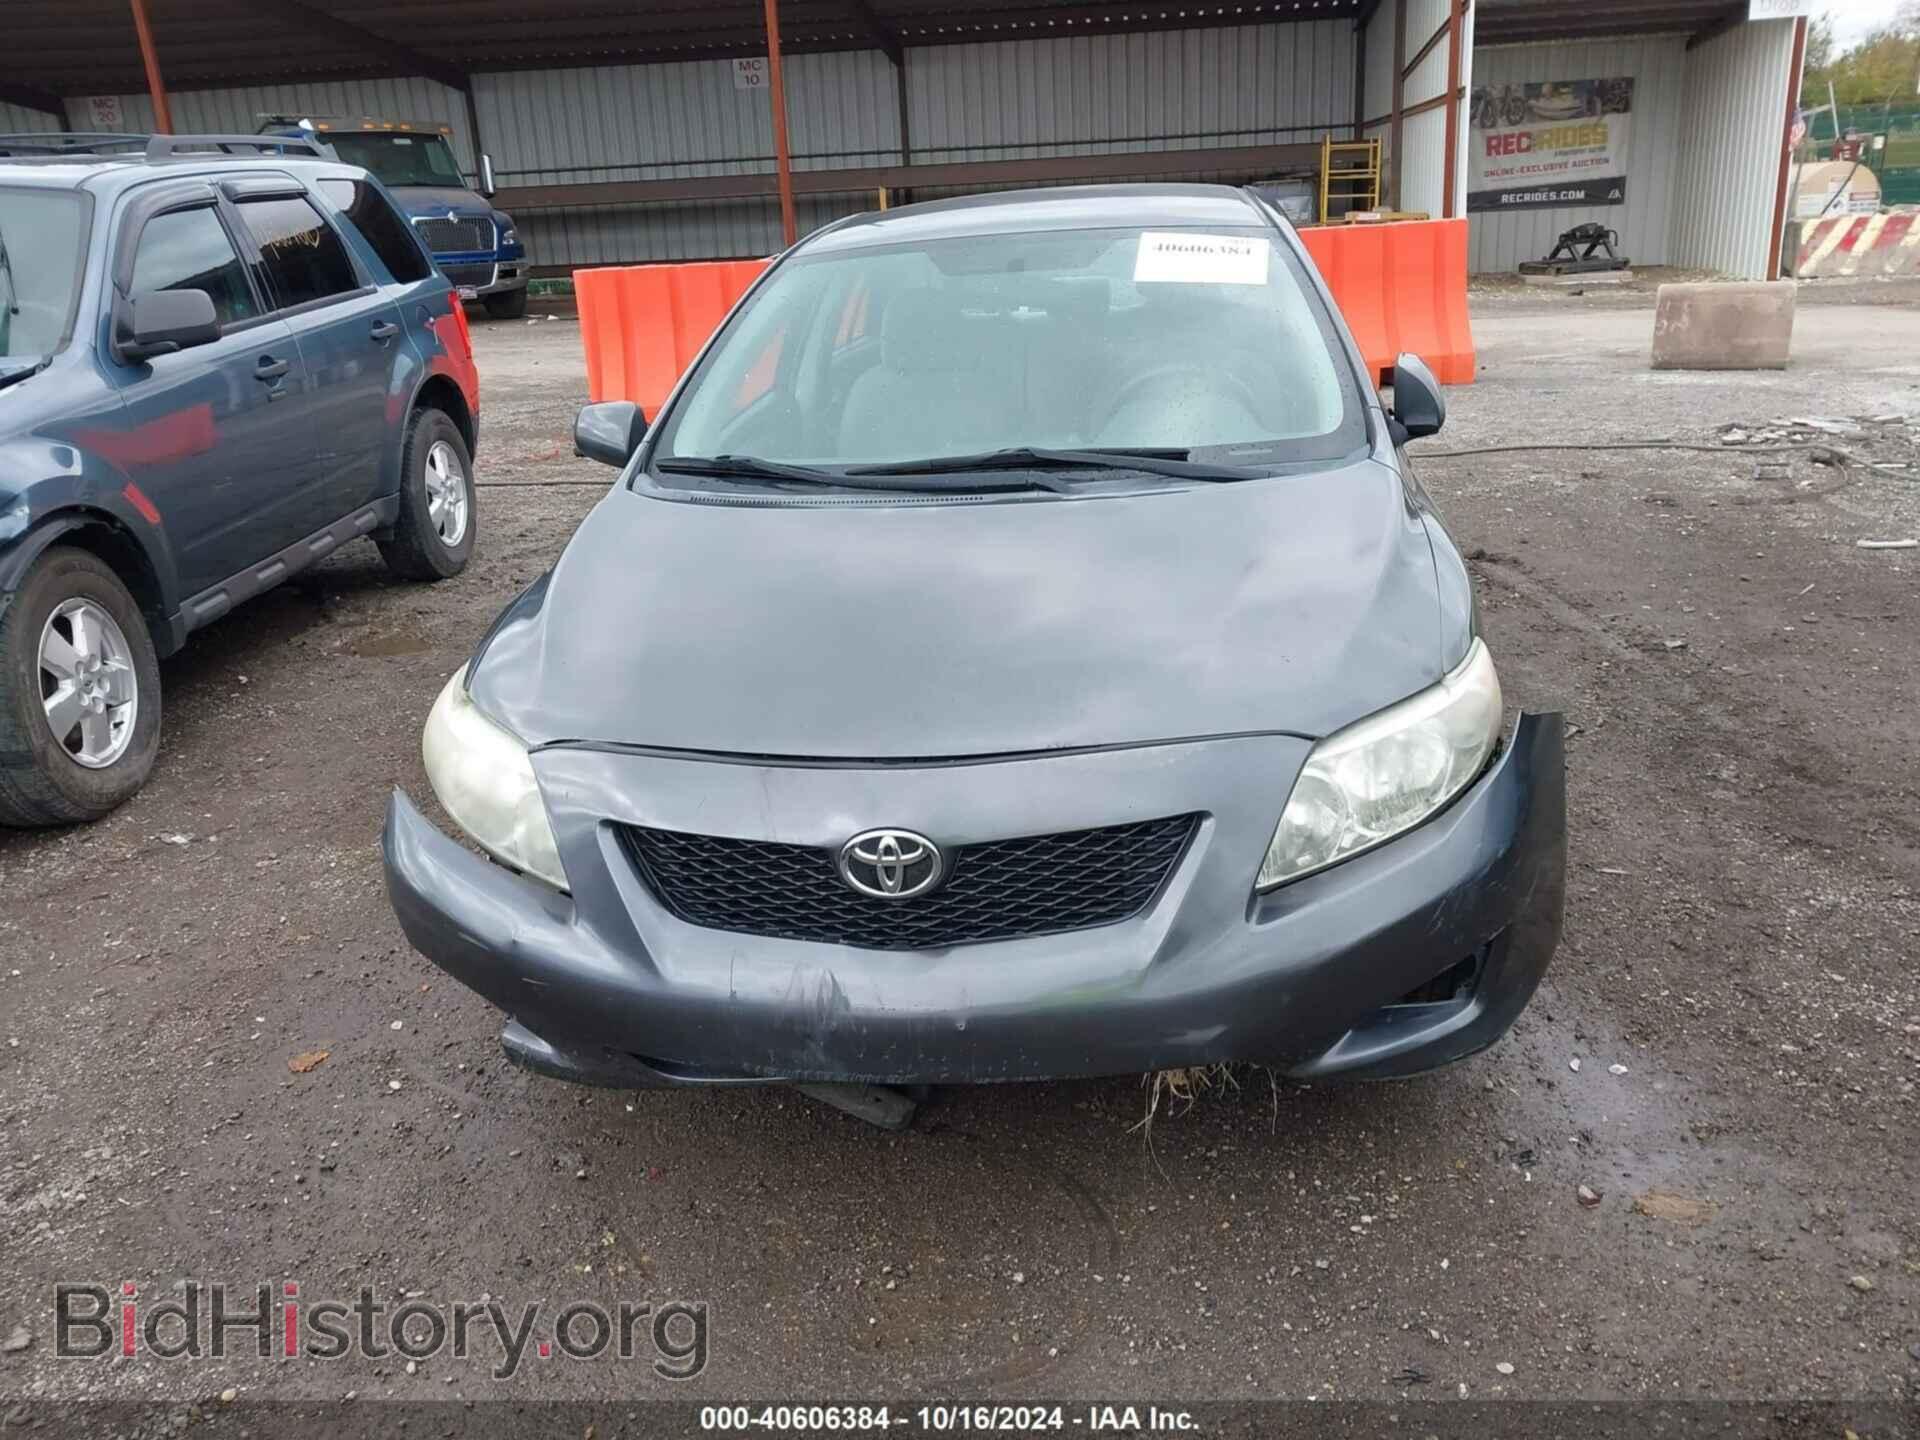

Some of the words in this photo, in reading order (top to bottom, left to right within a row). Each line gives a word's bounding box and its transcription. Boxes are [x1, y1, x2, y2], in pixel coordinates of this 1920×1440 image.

[739, 60, 761, 71] MC
[745, 74, 760, 85] 10
[92, 98, 114, 109] MC
[1484, 161, 1568, 178] ONLINE-EXCLUSIVE
[1571, 157, 1610, 169] AUCTION
[1501, 190, 1585, 204] RECRIDES.COM
